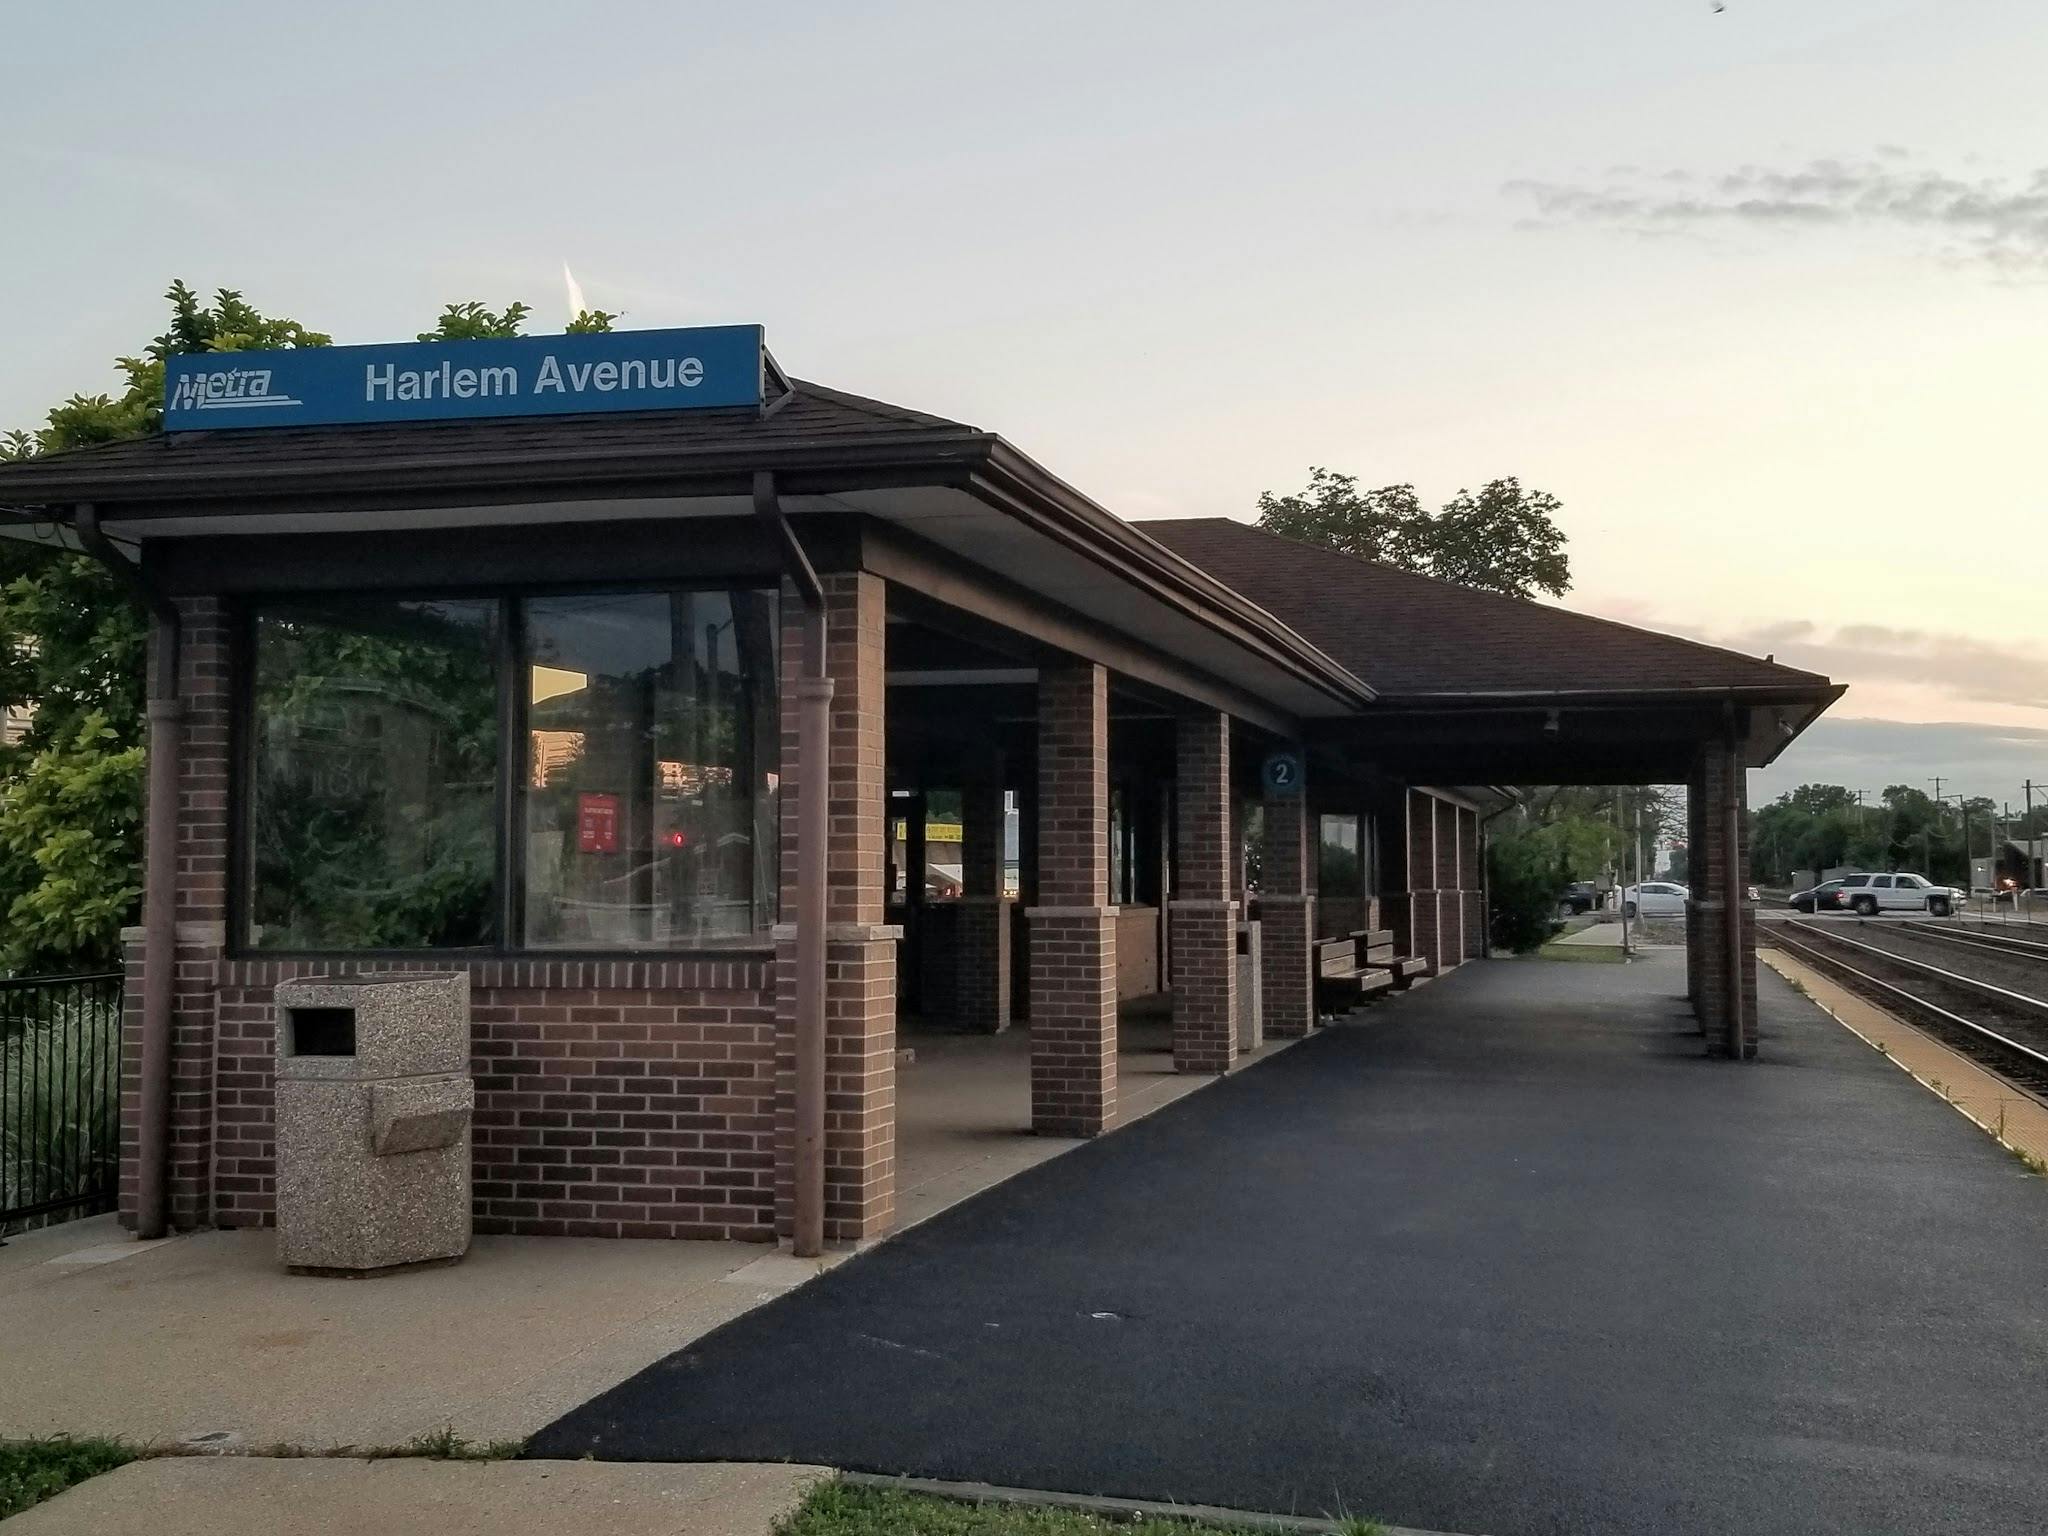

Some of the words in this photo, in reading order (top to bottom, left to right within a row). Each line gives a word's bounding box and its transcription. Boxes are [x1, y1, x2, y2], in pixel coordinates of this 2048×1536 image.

[170, 367, 272, 411] Metra
[366, 360, 518, 402] Harlem
[533, 355, 704, 394] Avenue
[1276, 764, 1289, 784] 2
